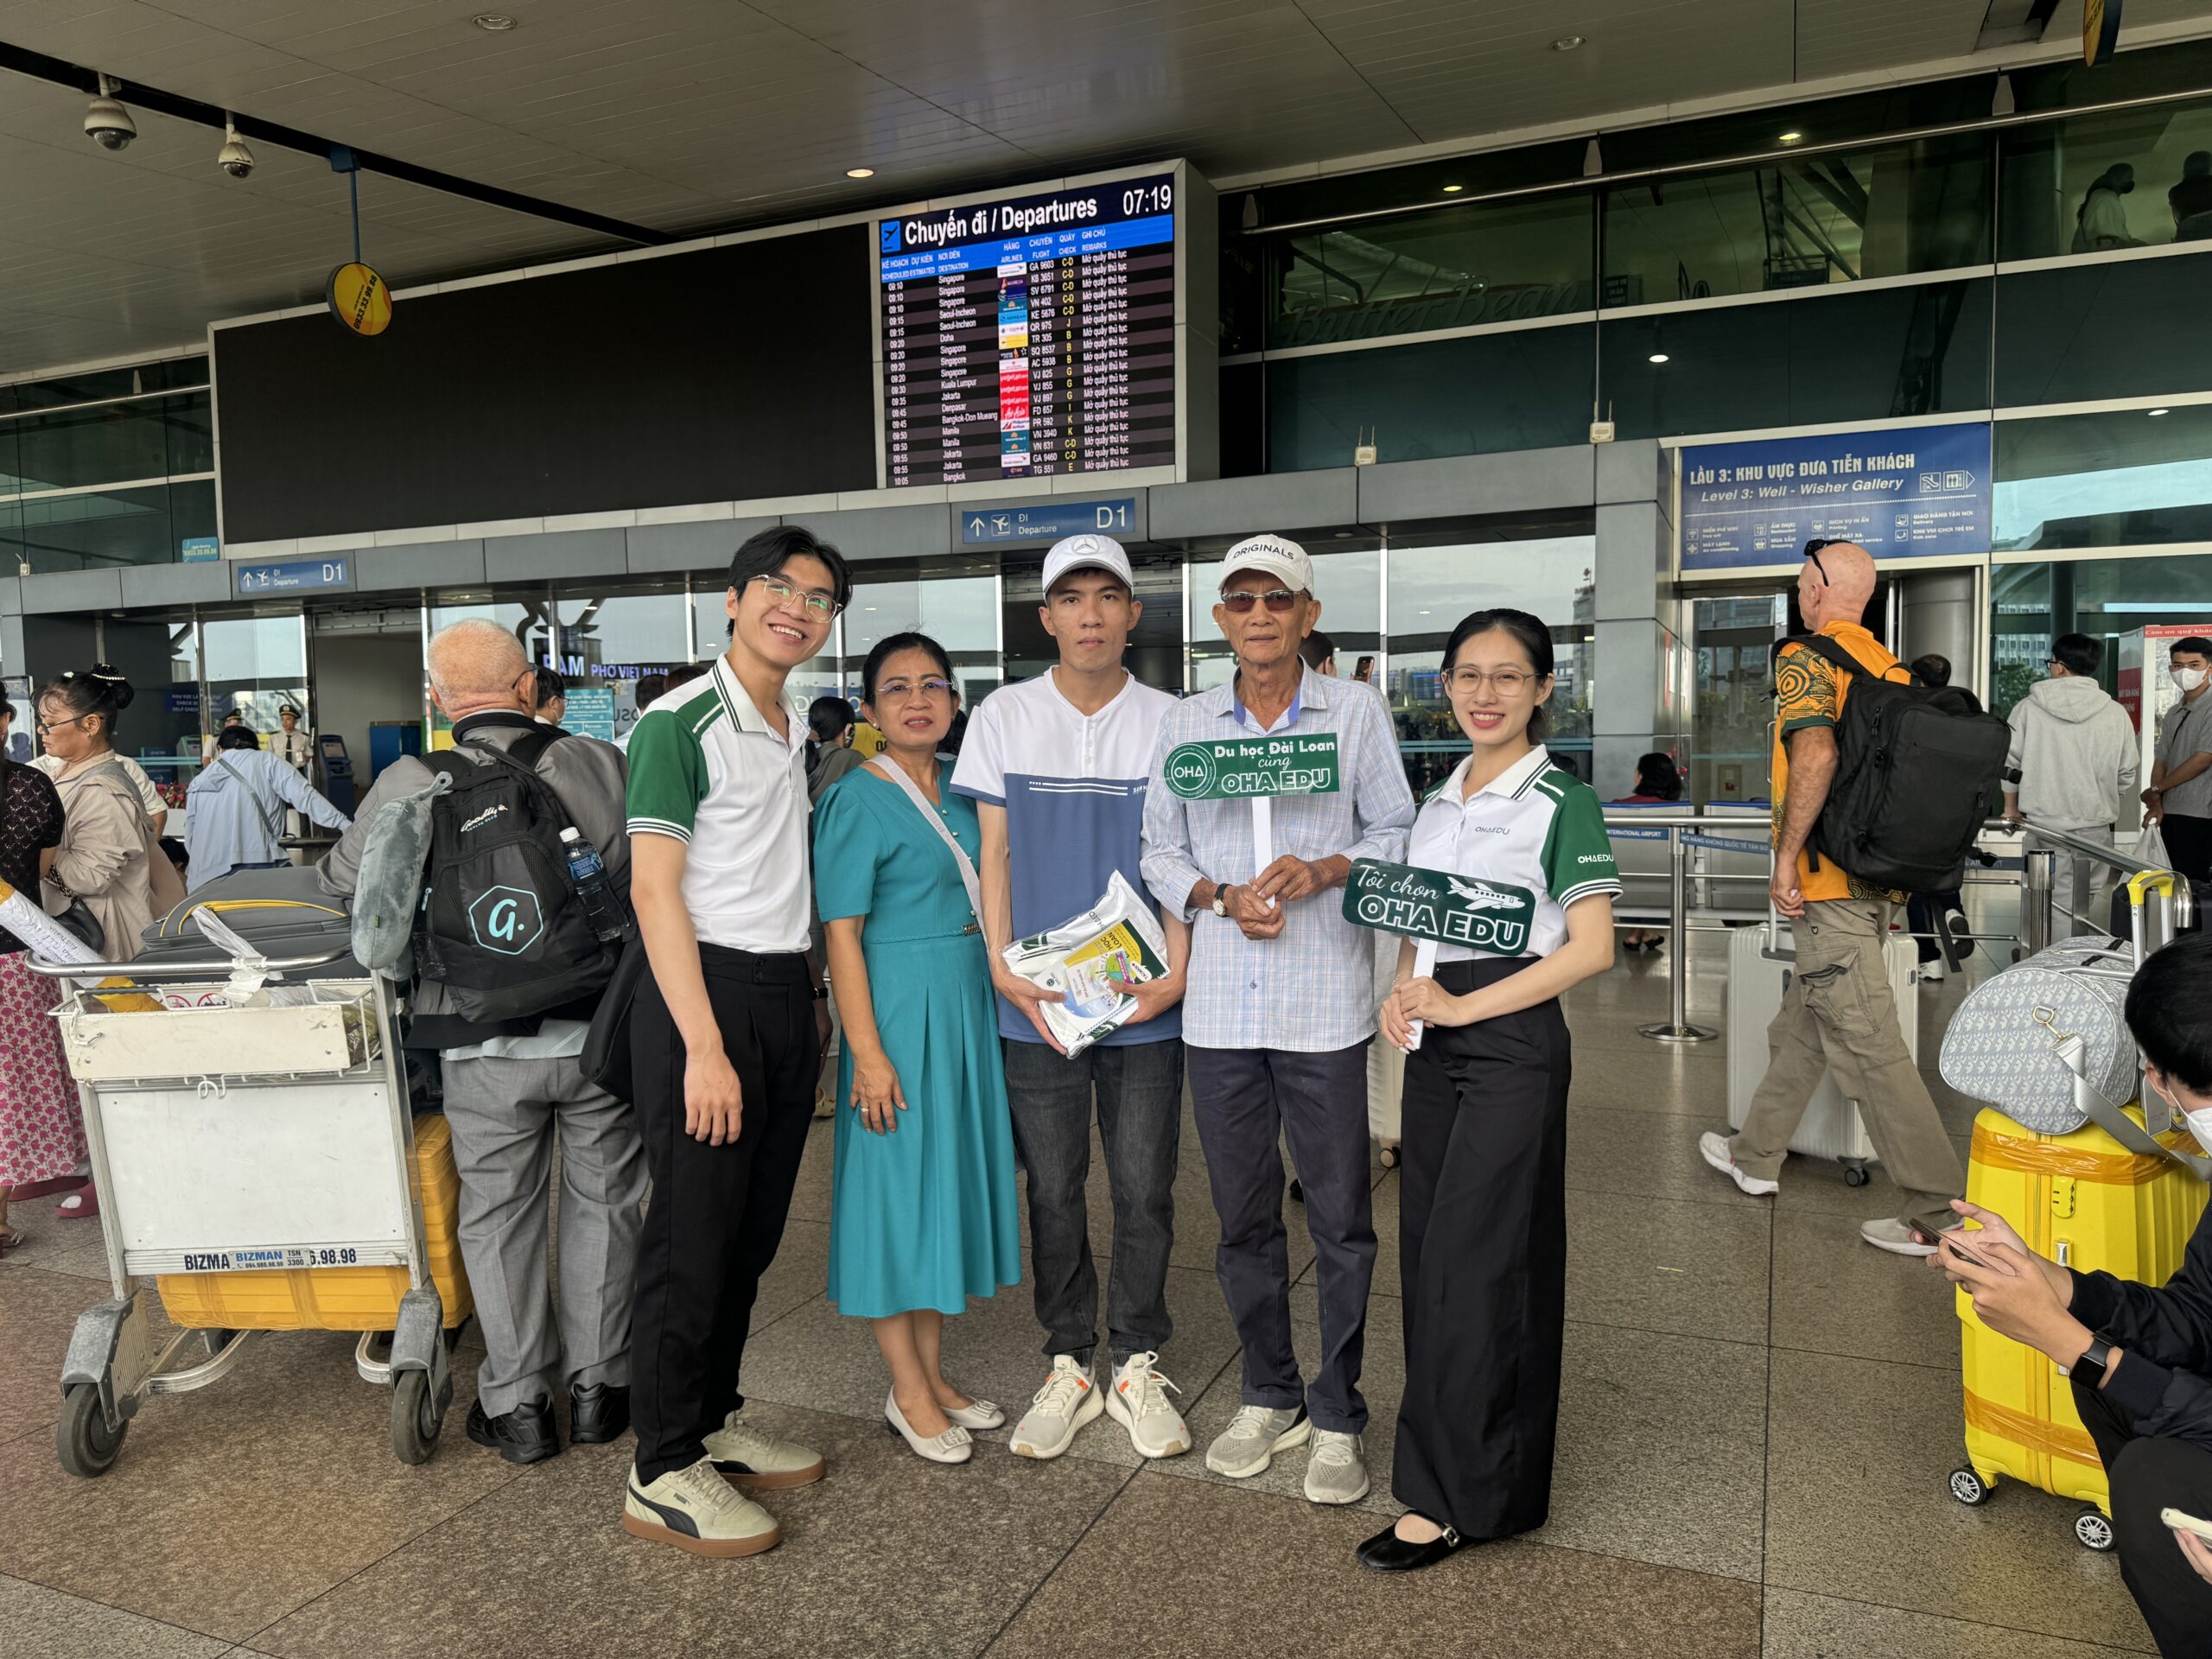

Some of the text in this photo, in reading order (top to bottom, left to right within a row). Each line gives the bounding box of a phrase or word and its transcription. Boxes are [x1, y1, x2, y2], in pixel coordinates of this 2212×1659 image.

[906, 185, 1172, 246] Chuyến đi / Departures 07:19
[1093, 227, 1106, 238] CHÚ
[882, 242, 1106, 280] SCHEDULED ESTIMATED DESTINATION AIRLINES FLIGHT CHECK REMARKS
[888, 274, 965, 291] 09:10 Singapore
[888, 287, 965, 302] 09:10 Singapore
[888, 298, 965, 314] 09:10 Singapore
[889, 308, 976, 326] 09:15 Seoul-Incheon
[889, 320, 976, 337] 09:15 Seoul-Incheon
[890, 334, 954, 348] 09:20 Doha
[890, 345, 966, 360] 09:20 Singapore
[891, 356, 967, 372] 09:20 Singapore
[891, 368, 967, 383] 09:20 Singapore
[891, 385, 906, 395] 09:30
[957, 378, 977, 388] Lumpur
[892, 391, 961, 406] 09:35 Jakarta
[892, 404, 967, 417] 09:45 Denpasar
[892, 420, 907, 429] 09:45
[942, 414, 976, 424] Bangkok-Don
[977, 411, 998, 421] Mueang
[943, 427, 959, 435] Manila
[893, 438, 960, 452] 09:50 Manila
[893, 450, 962, 463] 09:55 Jakarta
[893, 461, 962, 474] 09:55 Jakarta
[1690, 453, 1915, 485] LẦU 3: KHU VỰC ĐƯA TIỄN KHÁCH
[894, 472, 965, 486] 10:05 Bangkok
[1700, 488, 1737, 503] Level
[1740, 488, 1753, 500] 3:
[1758, 483, 1786, 499] Well
[1800, 480, 1847, 495] Wisher
[1852, 476, 1904, 494] Gallery
[1018, 505, 1125, 536] Departure D1
[1019, 513, 1028, 522] ĐI
[1233, 544, 1294, 560] ORIGINALS
[322, 563, 341, 582] D1
[1215, 741, 1335, 759] Du học Đài Loan
[1258, 755, 1292, 771] cùng
[1222, 768, 1331, 793] OHA EDU
[1357, 864, 1444, 900] Tôi chọn
[1357, 893, 1524, 950] OHA EDU
[184, 1254, 230, 1270] BIZMA
[236, 1251, 283, 1262] BIZMAN
